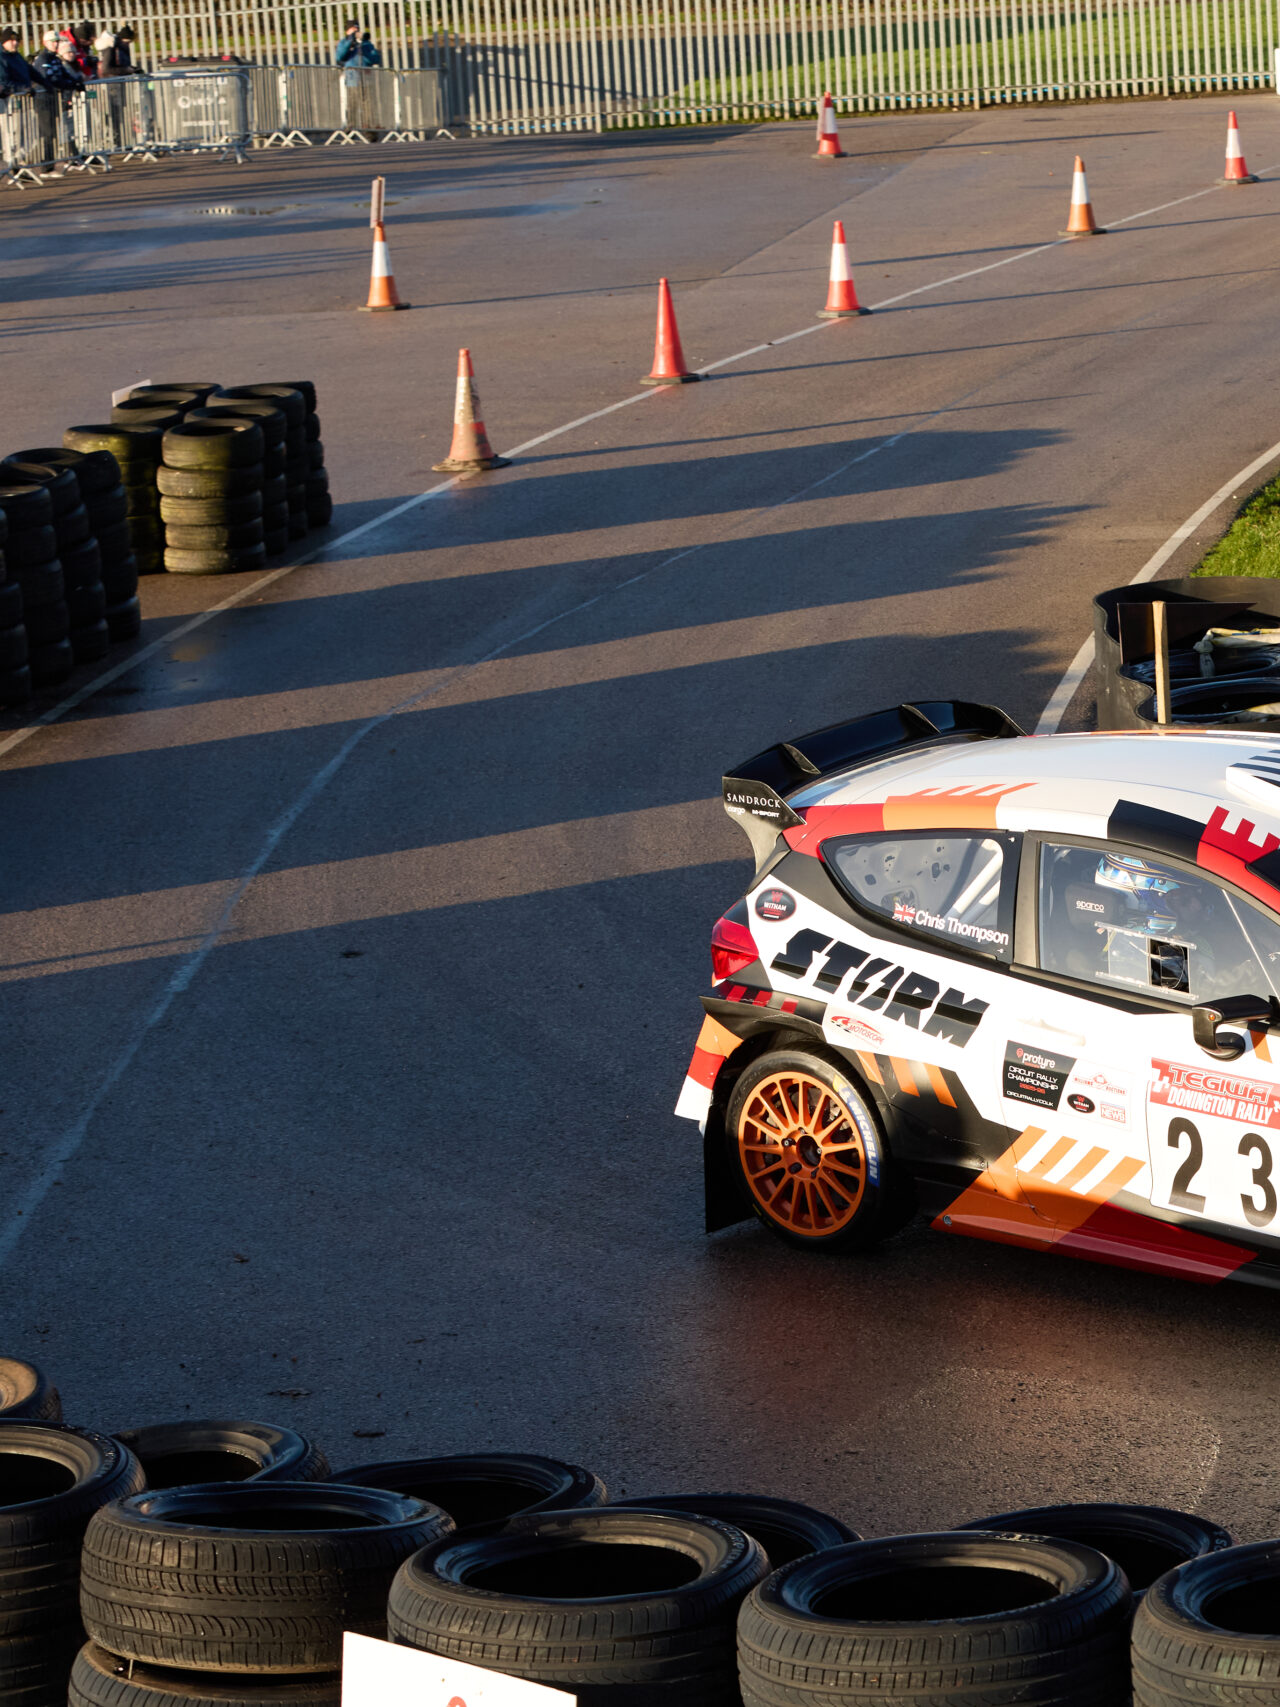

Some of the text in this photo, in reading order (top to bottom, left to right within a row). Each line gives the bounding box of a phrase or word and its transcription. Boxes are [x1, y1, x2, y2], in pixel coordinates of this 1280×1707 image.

[727, 793, 780, 808] SANDROCK
[764, 902, 787, 911] WITHAM
[1076, 900, 1104, 911] sparco
[915, 910, 1009, 945] Chris Thompson
[770, 928, 991, 1048] STORM
[1022, 1052, 1056, 1069] protyre
[1007, 1072, 1059, 1090] CHAMPIONSHIP
[1008, 1065, 1035, 1078] CIRCUIT
[1036, 1072, 1058, 1083] RALLY
[1169, 1065, 1273, 1104] TEGIWA
[1167, 1087, 1273, 1124] DONINGTON RALLY
[848, 1101, 877, 1179] MICHELIN
